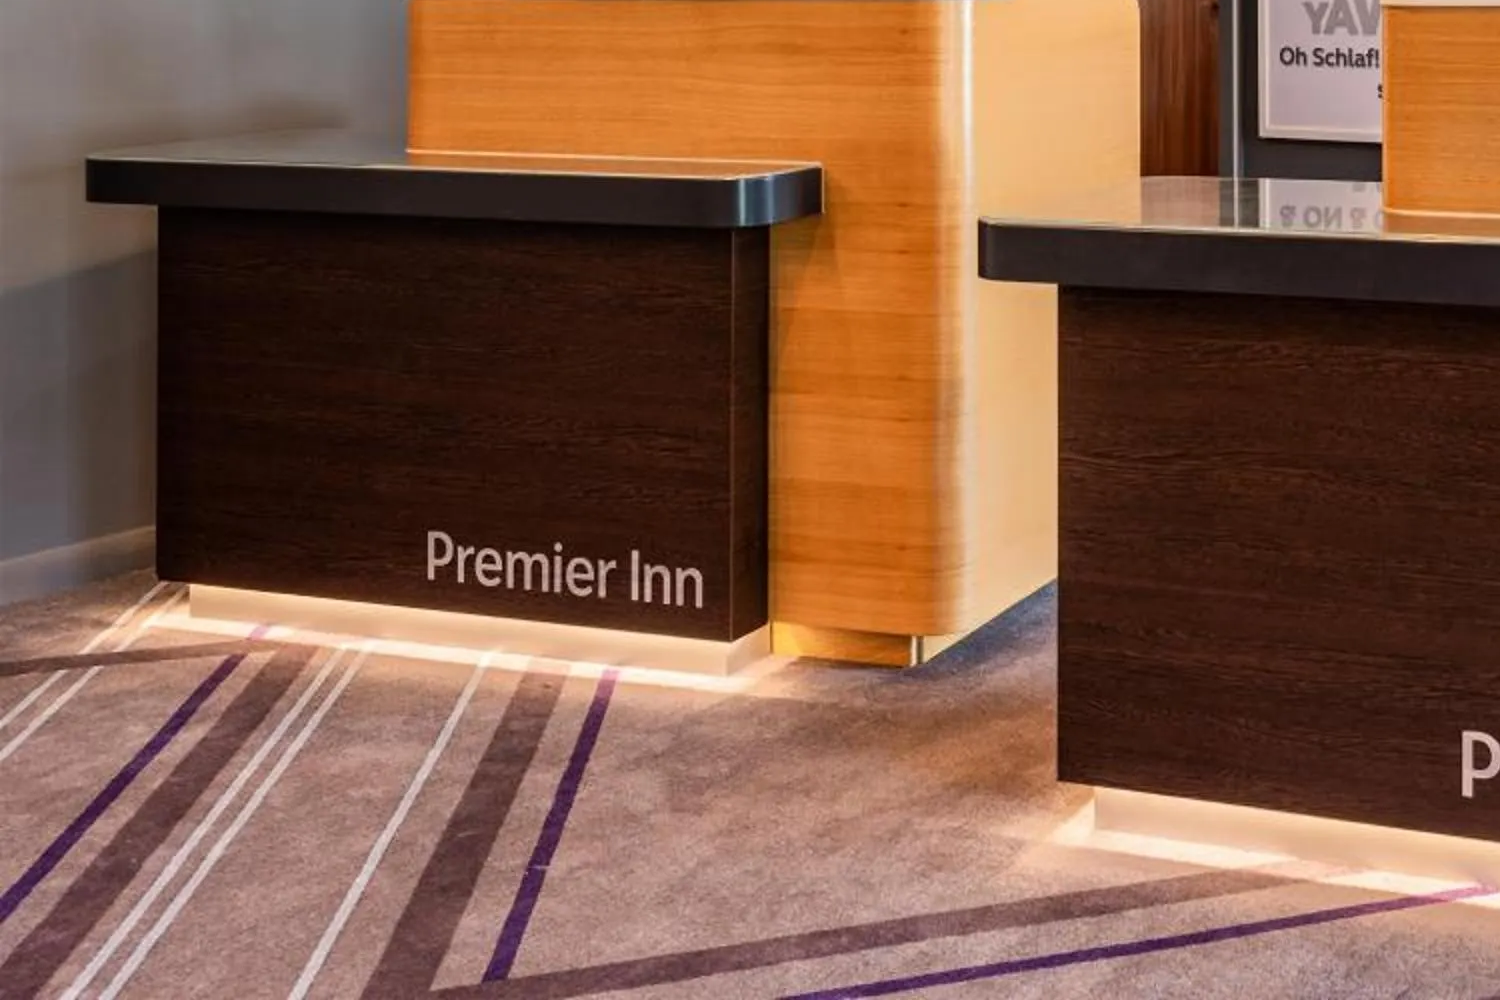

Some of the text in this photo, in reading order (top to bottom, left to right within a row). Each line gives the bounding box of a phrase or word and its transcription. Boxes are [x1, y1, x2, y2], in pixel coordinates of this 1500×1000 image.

[1279, 46, 1308, 68] Oh
[427, 530, 703, 609] Premier Inn
